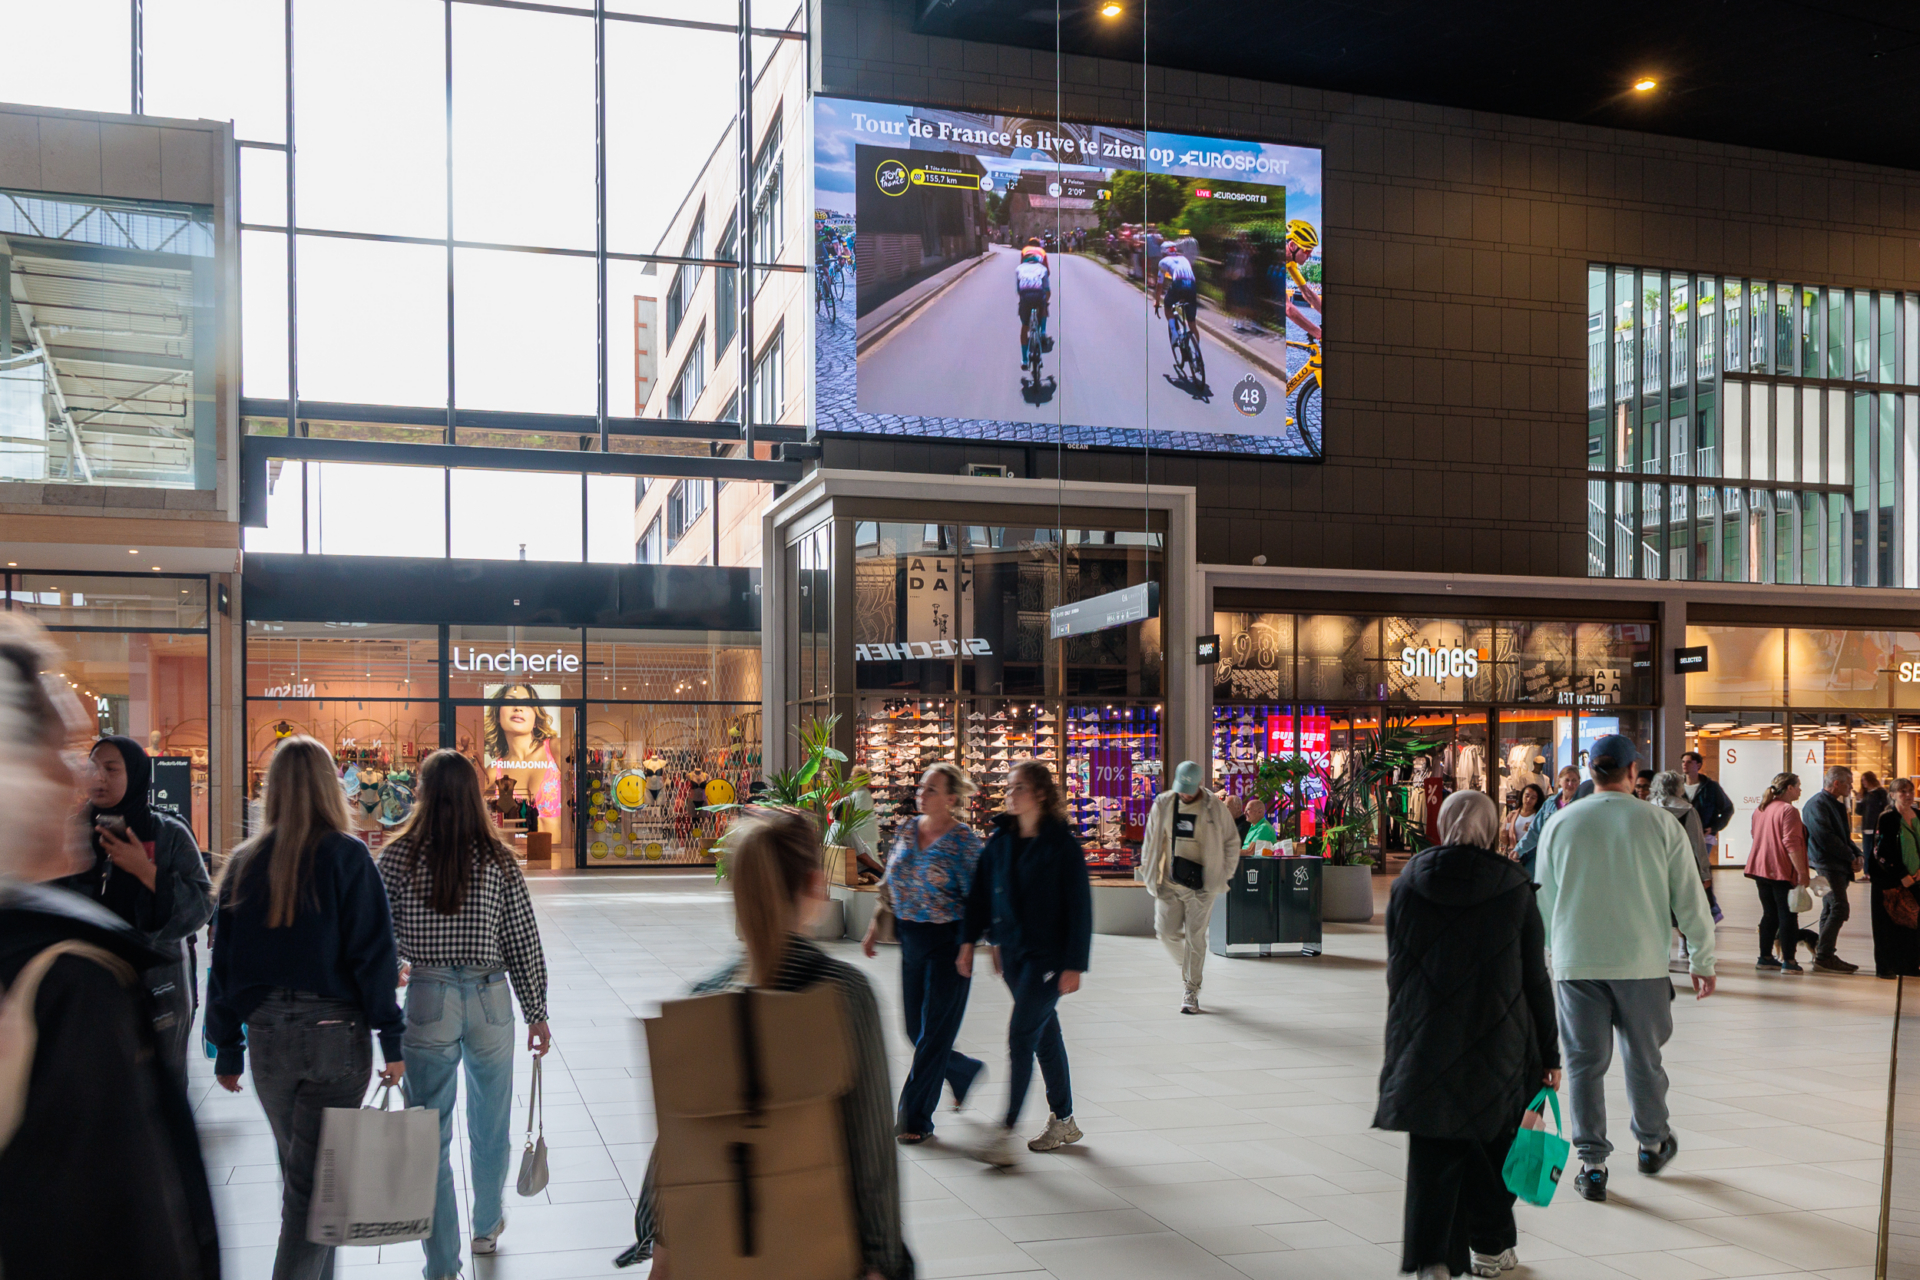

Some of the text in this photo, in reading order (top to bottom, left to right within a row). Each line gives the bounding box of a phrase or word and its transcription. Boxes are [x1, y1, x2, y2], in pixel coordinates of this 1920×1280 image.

[851, 112, 1289, 175] Tour de France is live te zien op EUROSPORT
[925, 174, 957, 184] 155,7 km
[1217, 191, 1260, 202] EUROSPORT
[1240, 389, 1259, 404] 48
[453, 646, 579, 673] Lincherie
[1401, 646, 1478, 684] snipes
[1680, 656, 1703, 664] SELECTED
[1283, 740, 1313, 748] SLE
[491, 760, 554, 769] PRIMADONNA
[1096, 766, 1125, 782] 70%
[1129, 812, 1150, 827] 50
